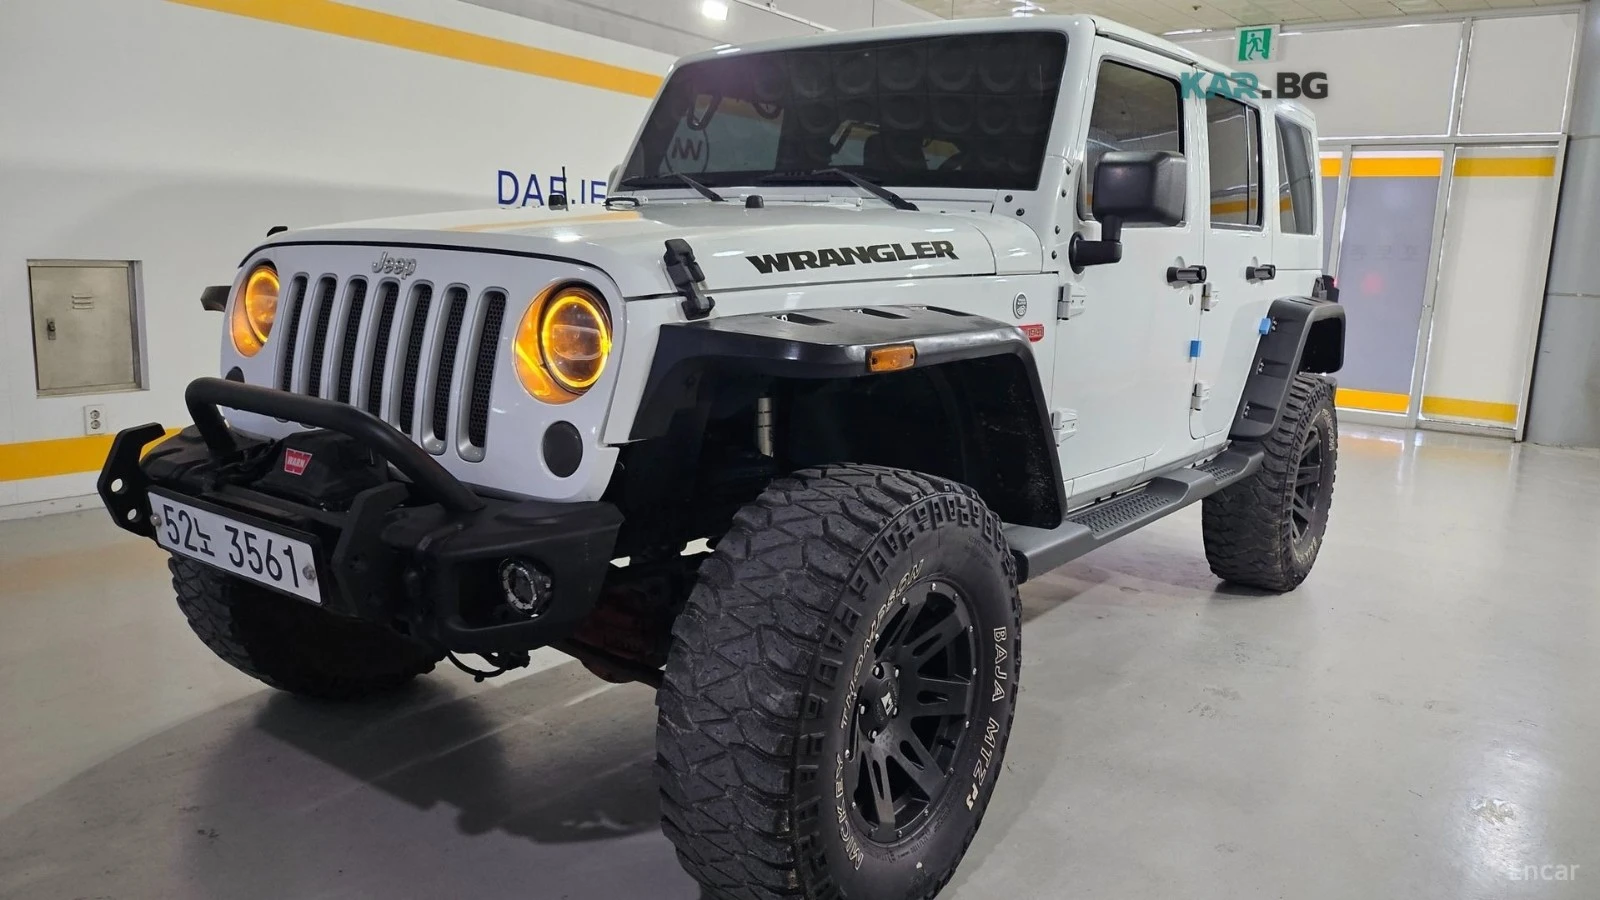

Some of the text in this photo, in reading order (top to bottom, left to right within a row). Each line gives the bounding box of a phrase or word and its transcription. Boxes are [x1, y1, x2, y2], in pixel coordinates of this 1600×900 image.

[372, 251, 417, 280] Jeep
[745, 240, 960, 274] WRANGLER
[287, 455, 306, 468] WARN
[163, 504, 299, 588] 52노 3561
[991, 626, 1008, 702] BAJA
[835, 753, 864, 871] MICKEY
